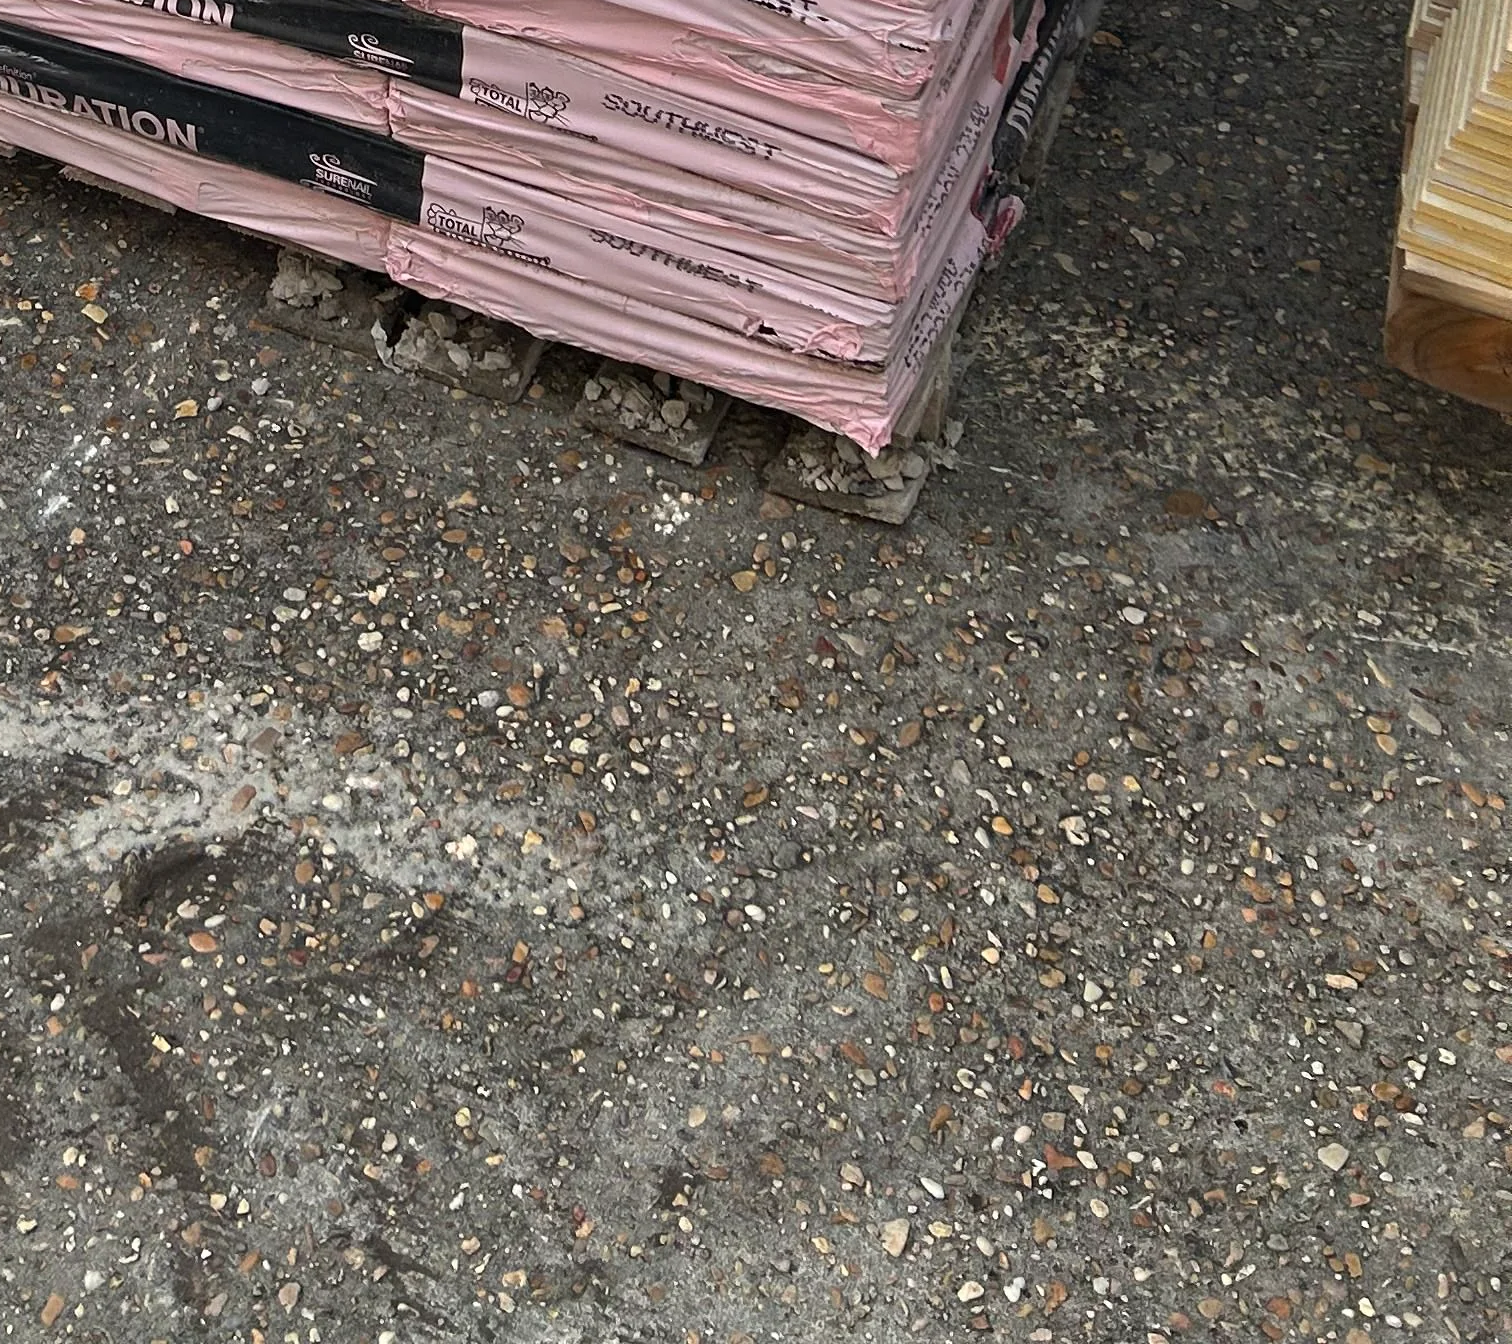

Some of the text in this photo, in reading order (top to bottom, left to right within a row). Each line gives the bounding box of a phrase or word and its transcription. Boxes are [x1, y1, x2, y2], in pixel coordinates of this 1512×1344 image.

[481, 86, 523, 113] TOTAL
[315, 167, 372, 197] SURENAIL
[437, 216, 478, 239] TOTAL
